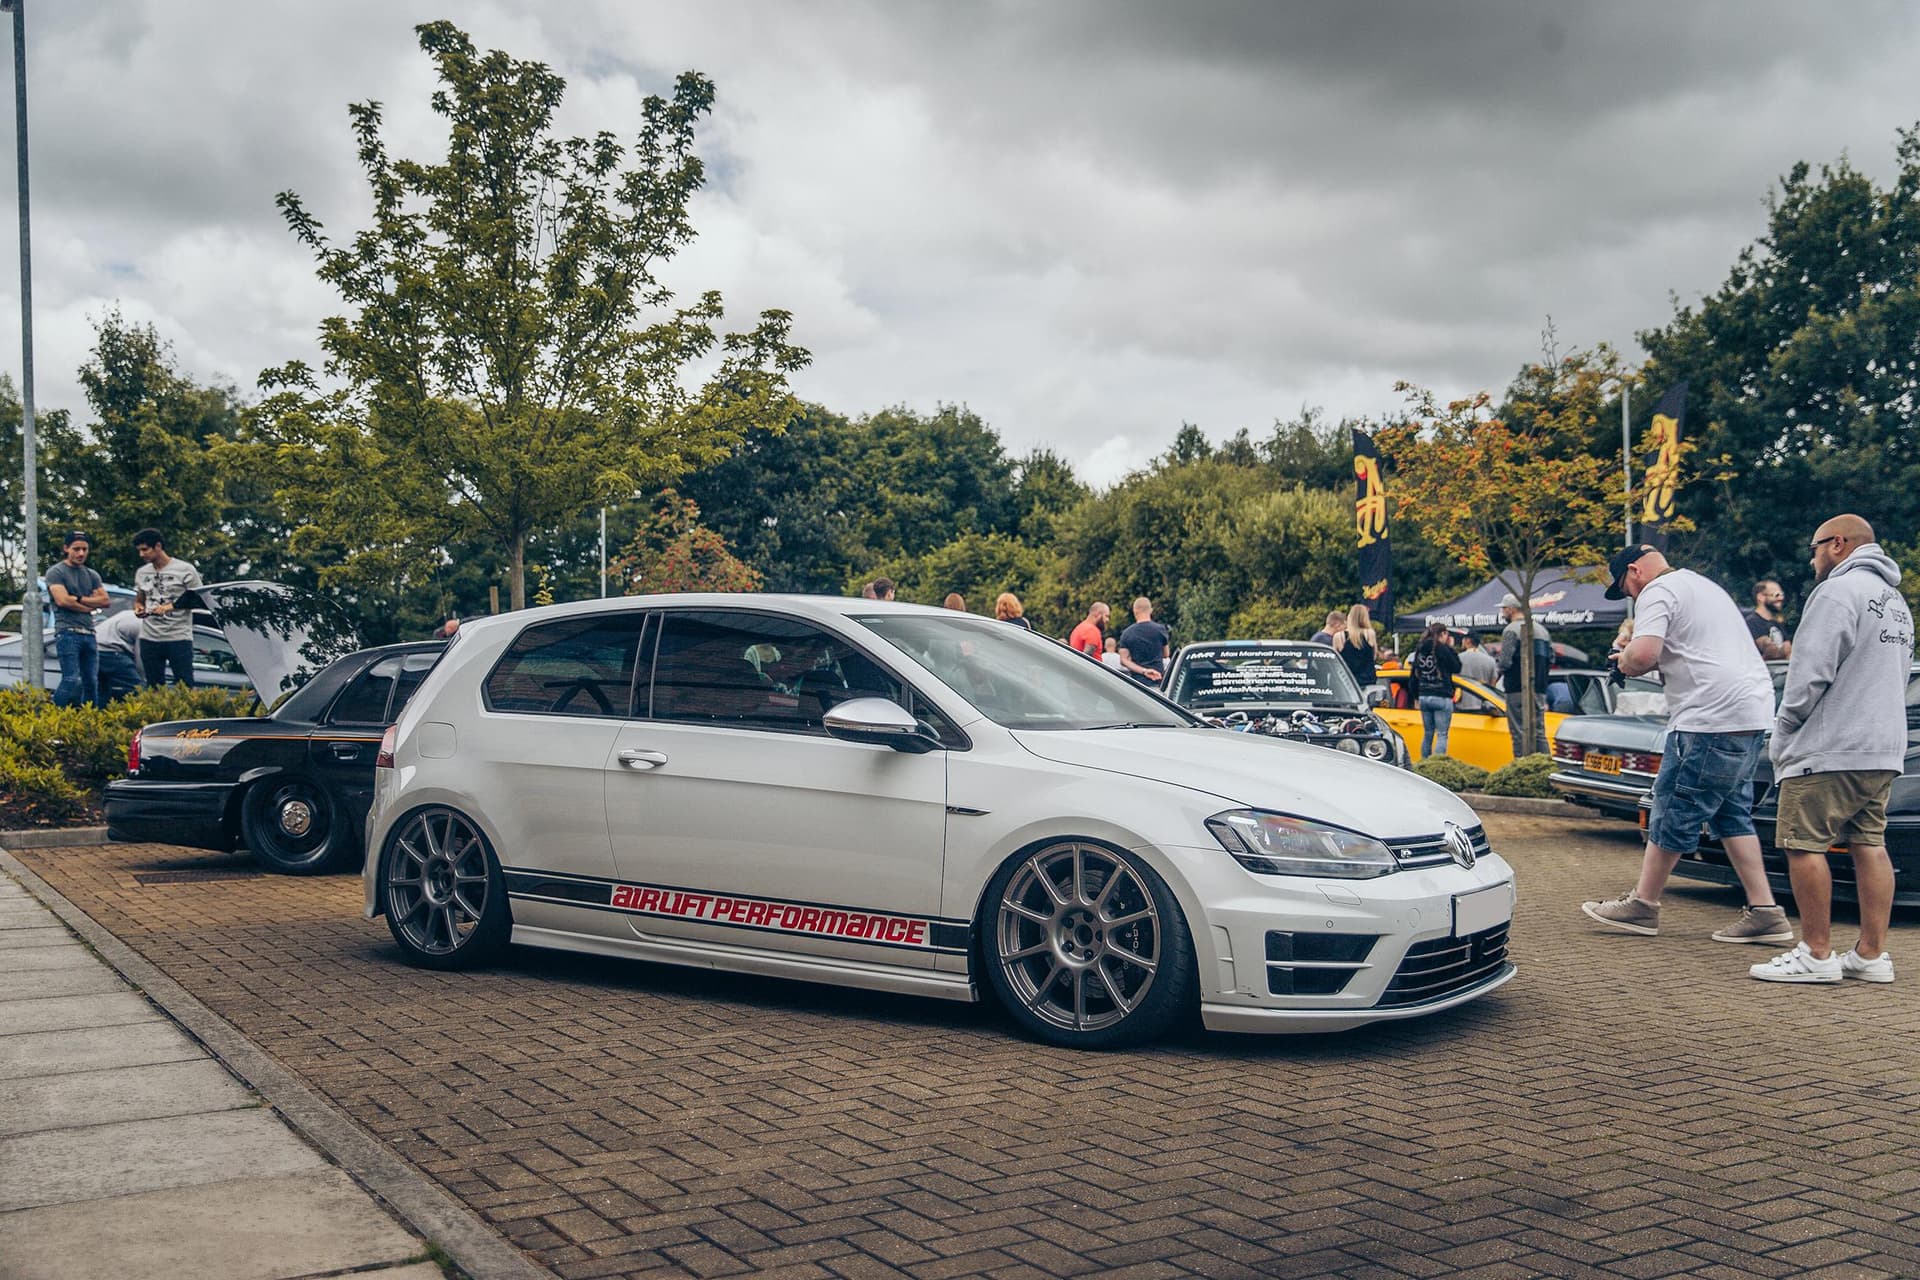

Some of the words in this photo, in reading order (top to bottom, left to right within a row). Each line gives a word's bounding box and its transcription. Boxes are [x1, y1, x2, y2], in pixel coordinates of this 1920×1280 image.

[1454, 614, 1473, 626] Who
[1474, 613, 1497, 625] Know
[1545, 609, 1594, 625] Meguiar's
[1273, 650, 1302, 658] Racing
